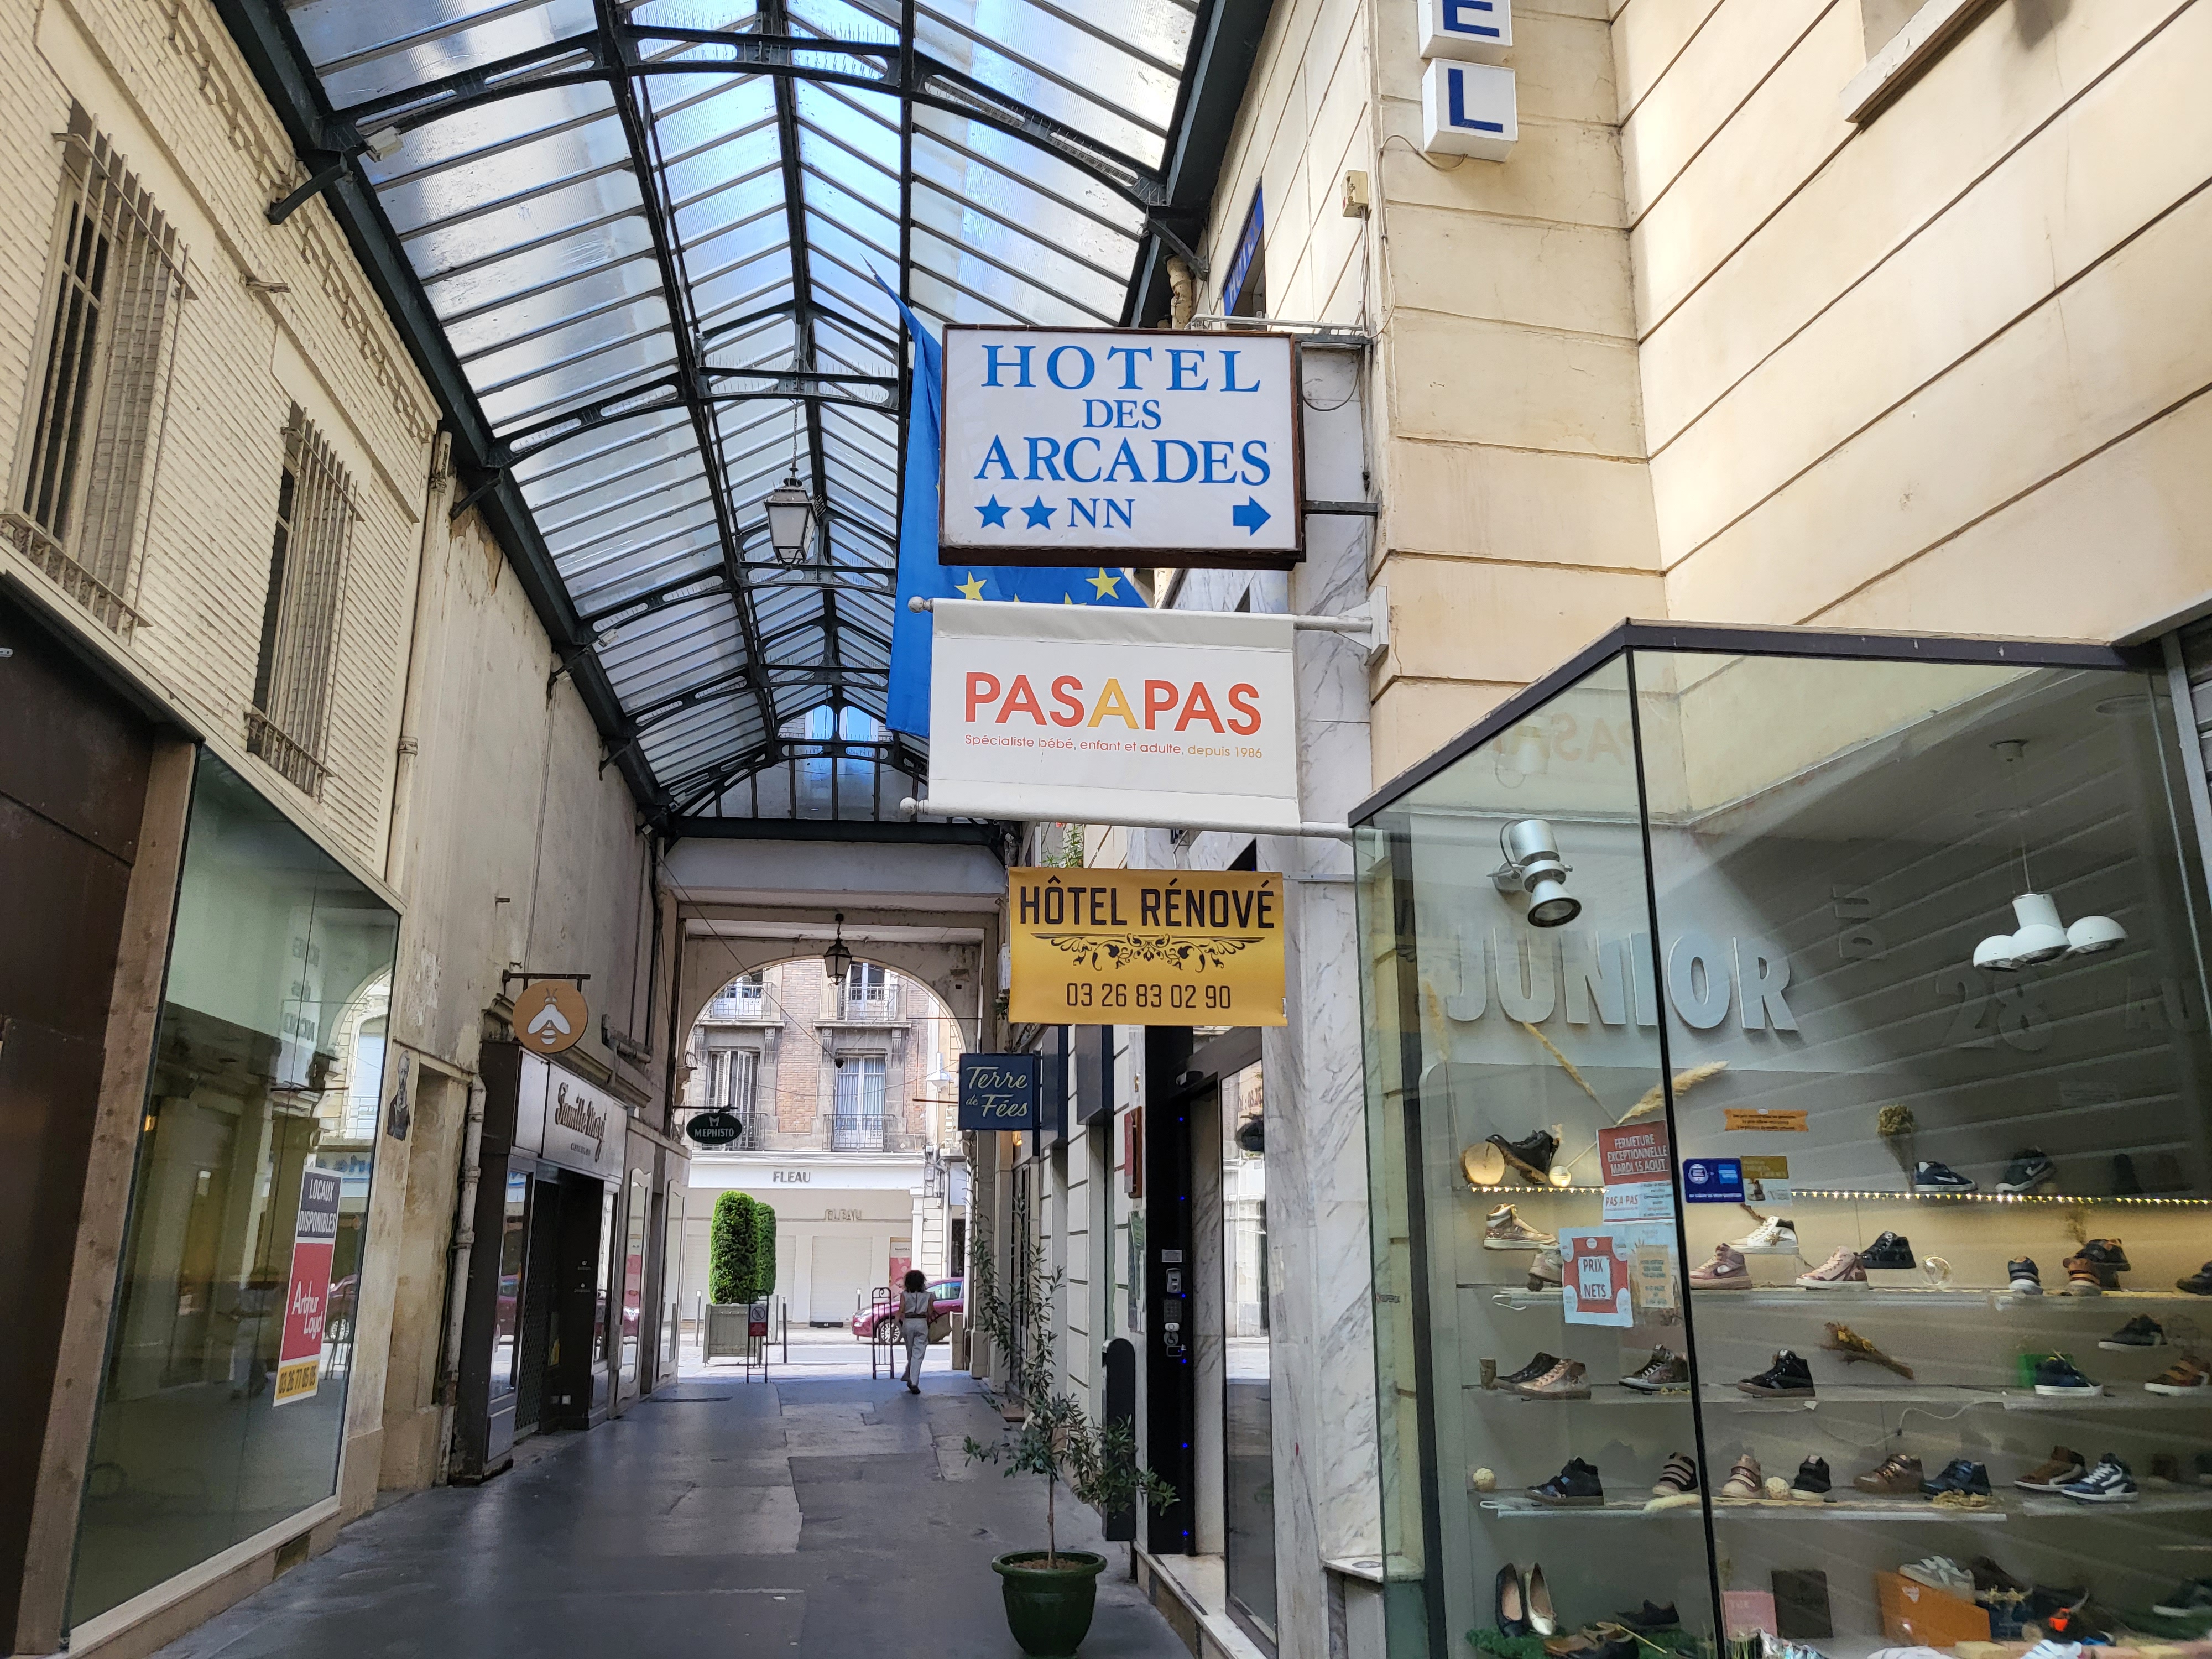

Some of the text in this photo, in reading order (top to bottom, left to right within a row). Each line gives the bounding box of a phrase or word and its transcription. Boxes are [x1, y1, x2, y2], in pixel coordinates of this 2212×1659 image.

[981, 345, 1261, 392] HOTEL
[1082, 399, 1161, 430] DES
[974, 434, 1271, 486] ARCADES
[1067, 497, 1135, 529] NN
[965, 735, 1262, 758] Spécialiste bébé, enfant et adulte, depuis 1986
[1020, 875, 1275, 928] HÔTEL RÉNOVÉ
[1446, 926, 1799, 1030] JUNIOR
[1067, 983, 1231, 1009] 03 26 83 02 90
[966, 1066, 1028, 1089] Terre
[965, 1094, 1027, 1117] de Fées
[695, 1128, 734, 1138] MEPHISTO
[1614, 1134, 1655, 1149] FERMETURE
[1607, 1145, 1668, 1162] EXCEPTIONNELLE
[773, 1171, 811, 1183] FLEAU
[1610, 1162, 1634, 1175] MARDI
[1635, 1161, 1644, 1172] 15
[309, 1178, 335, 1202] LOCAUX
[1605, 1196, 1618, 1207] PAS
[1625, 1194, 1639, 1204] PAS
[299, 1210, 336, 1233] DISPONIBLES
[1583, 1258, 1604, 1272] PRIX
[291, 1280, 320, 1315] Arthur
[1584, 1284, 1606, 1298] NETS
[304, 1310, 324, 1340] Loyd
